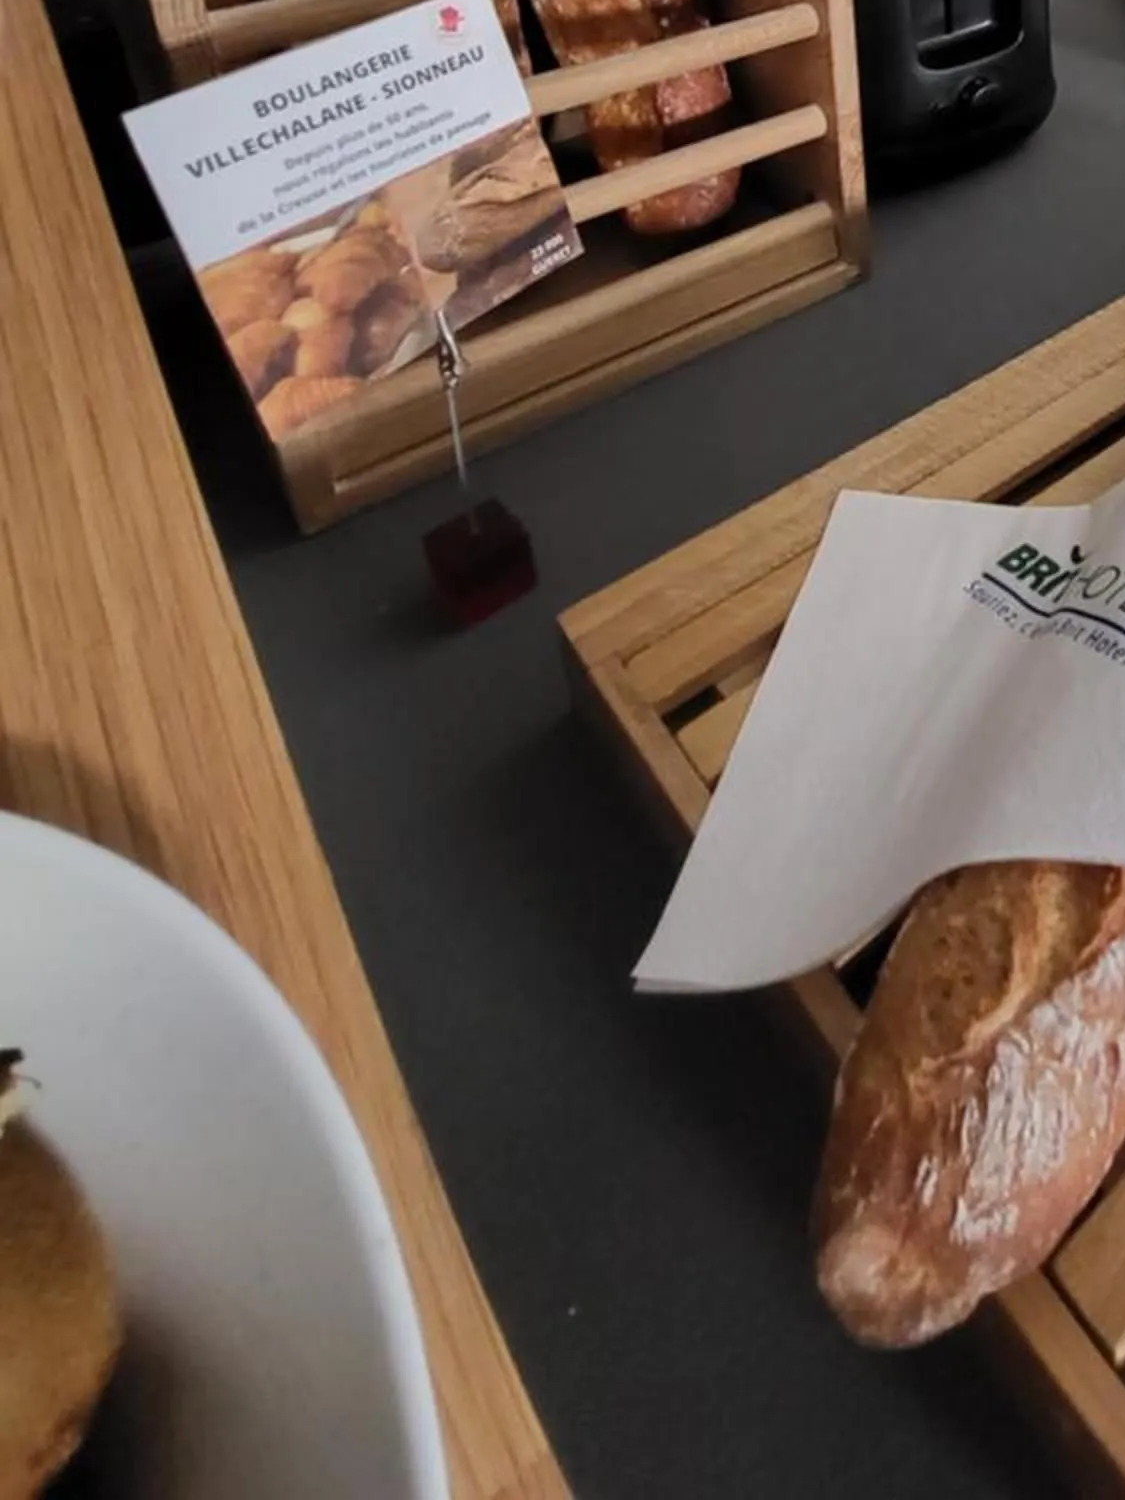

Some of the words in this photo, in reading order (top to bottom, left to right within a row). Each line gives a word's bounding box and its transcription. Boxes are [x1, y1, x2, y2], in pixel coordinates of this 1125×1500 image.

[184, 93, 367, 179] VILLECHALANE
[381, 44, 485, 100] SIONNEAU
[253, 44, 412, 119] BOULANGERIE
